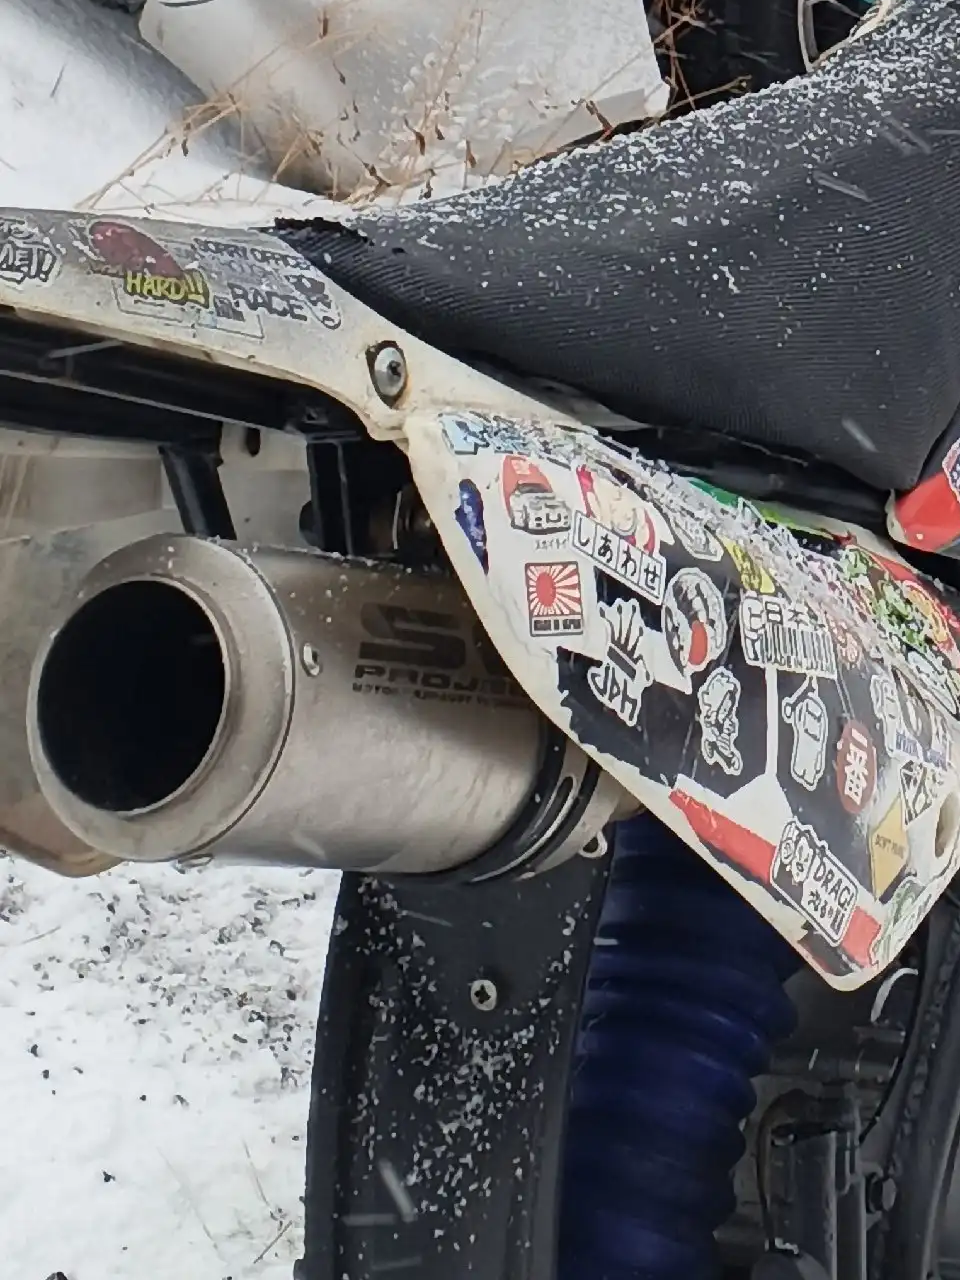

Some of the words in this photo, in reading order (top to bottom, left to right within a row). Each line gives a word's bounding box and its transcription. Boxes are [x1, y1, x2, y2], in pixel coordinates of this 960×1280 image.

[576, 517, 661, 591] しあわせ
[844, 727, 869, 806] 一番
[812, 861, 855, 912] DRAG!
